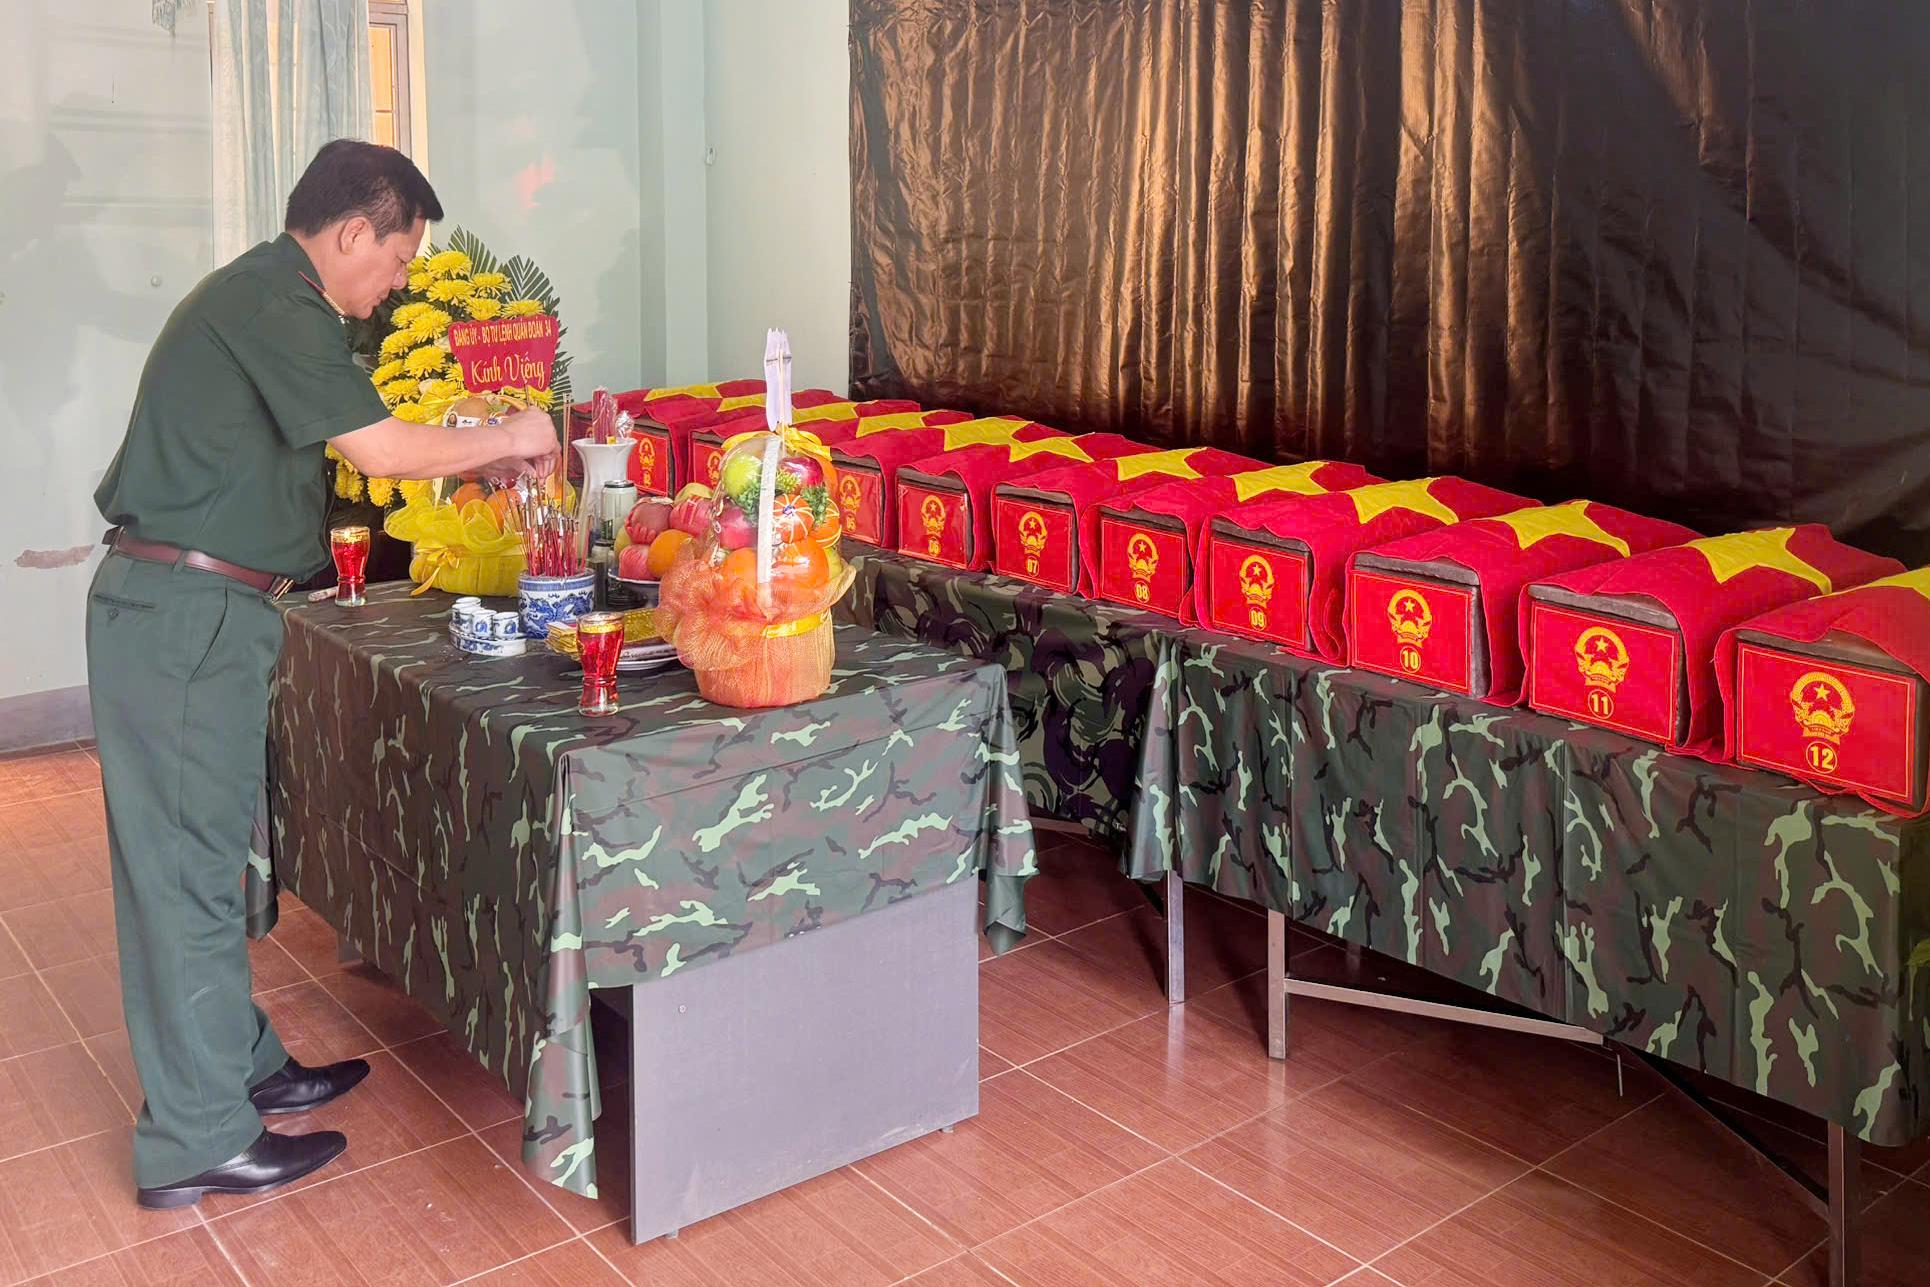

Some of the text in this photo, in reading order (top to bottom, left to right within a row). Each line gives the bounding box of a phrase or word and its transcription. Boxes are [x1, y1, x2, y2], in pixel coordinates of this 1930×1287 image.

[454, 325, 470, 346] ĐẢNG
[482, 323, 490, 347] BỘ
[500, 322, 512, 345] LỆNH
[513, 318, 528, 341] QUÂN
[528, 317, 543, 338] ĐOÀN
[471, 351, 544, 389] Kính Viếng
[1027, 559, 1037, 574] 07
[1136, 584, 1148, 600] 08
[1251, 610, 1265, 627] 09
[1402, 650, 1419, 669] 10
[1592, 694, 1609, 715] 11
[1810, 746, 1834, 770] 12
